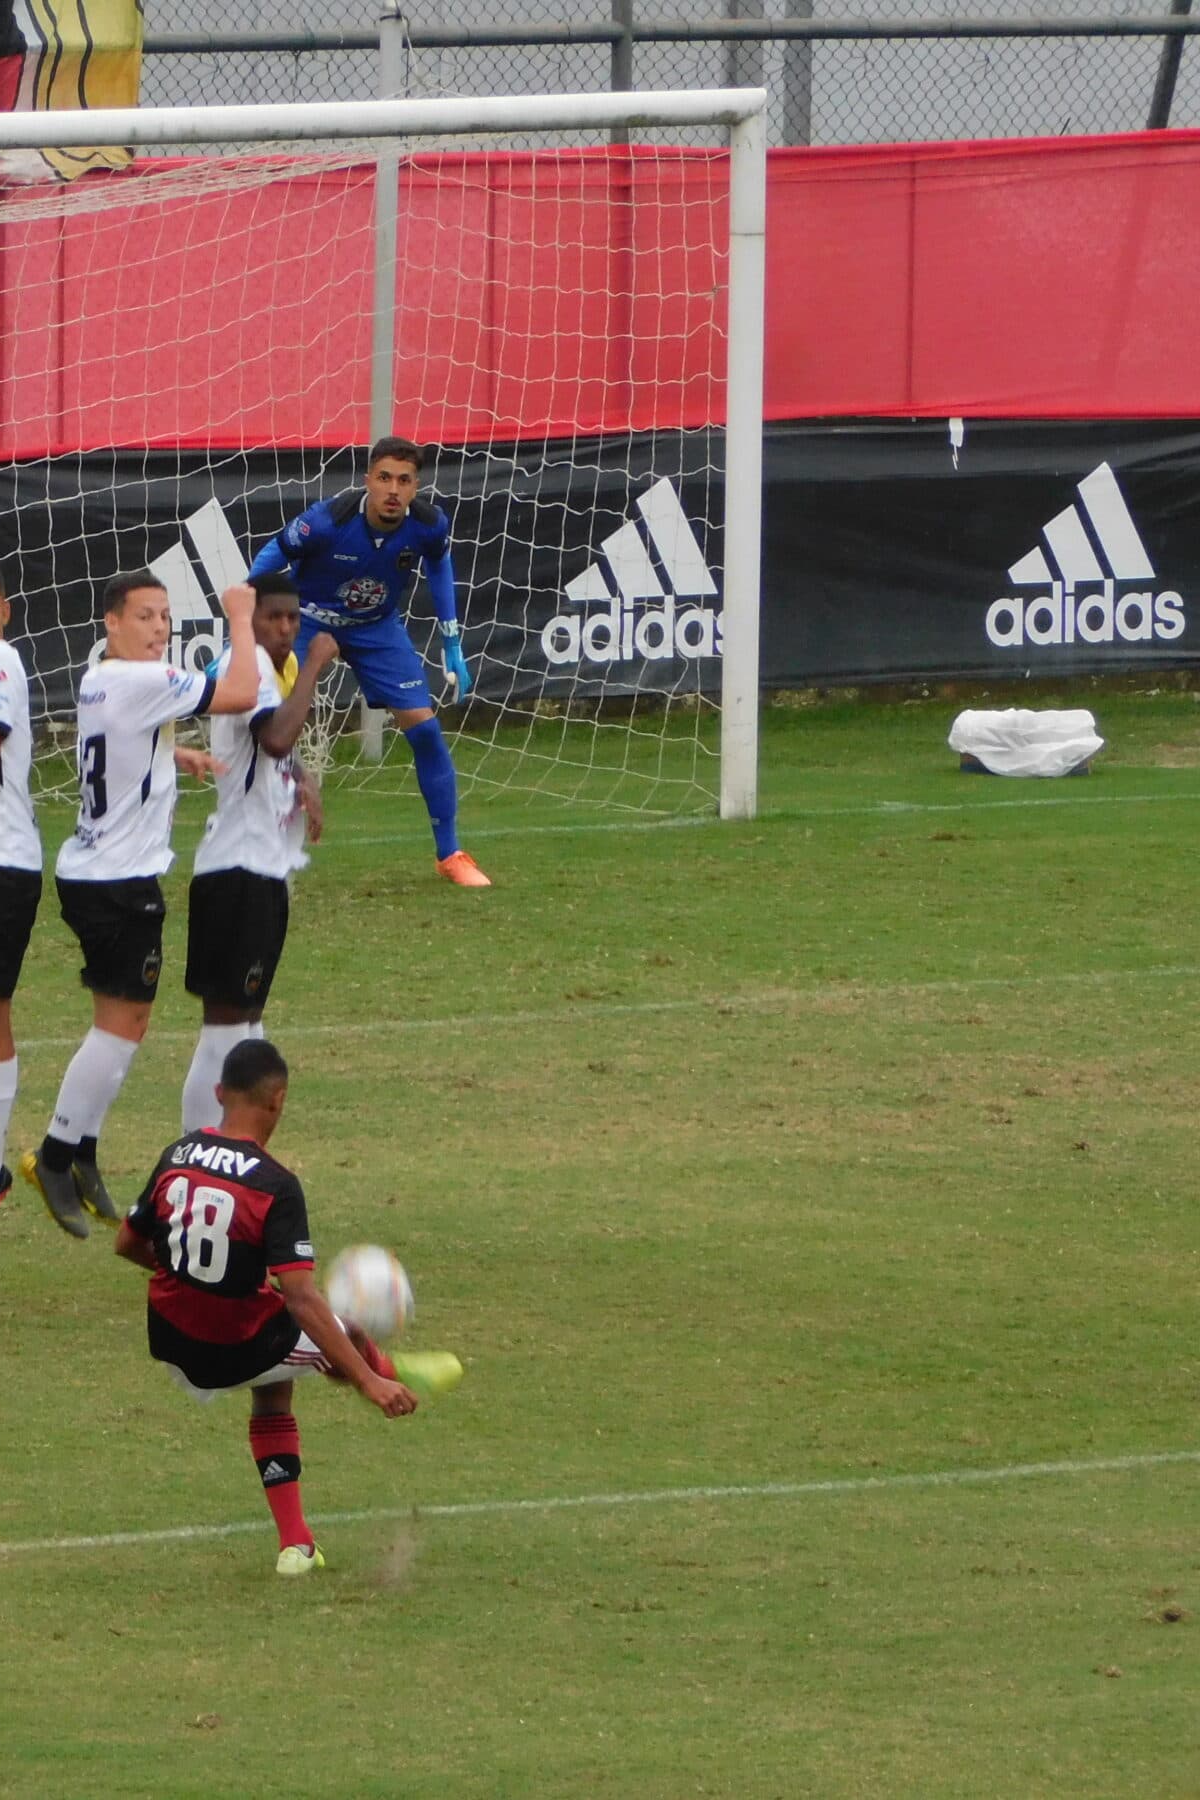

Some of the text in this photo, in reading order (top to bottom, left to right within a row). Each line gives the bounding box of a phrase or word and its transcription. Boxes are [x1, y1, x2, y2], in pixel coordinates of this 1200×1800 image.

[541, 594, 724, 664] adida
[985, 578, 1185, 646] adidas
[188, 1143, 260, 1176] MRV
[166, 1176, 235, 1283] 18
